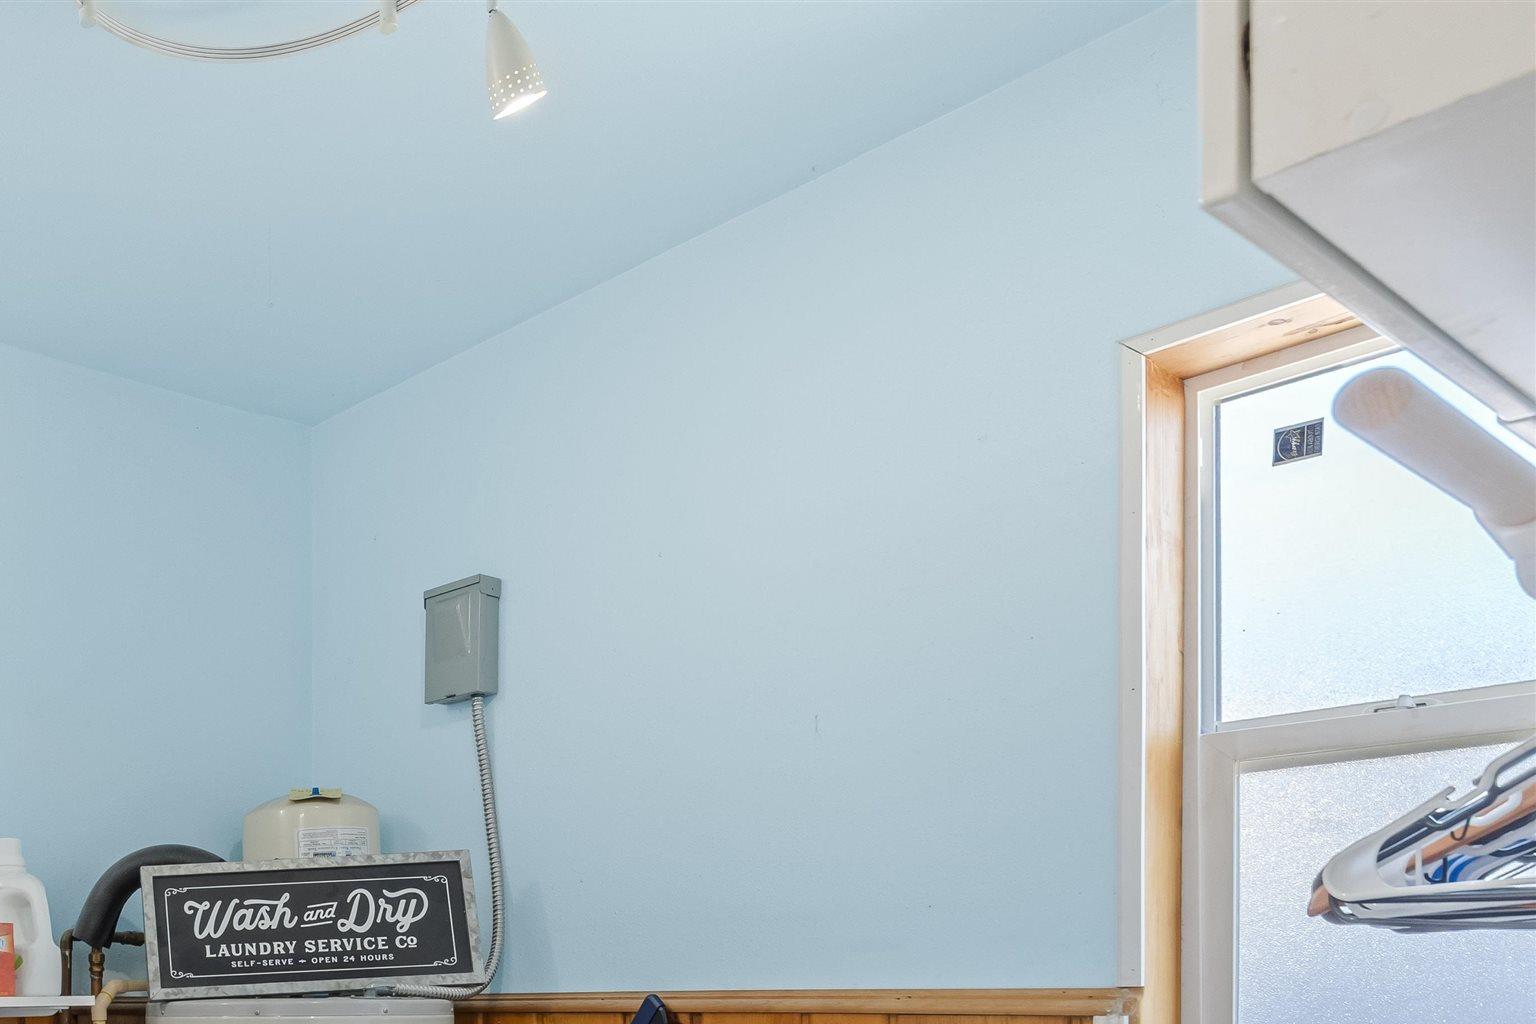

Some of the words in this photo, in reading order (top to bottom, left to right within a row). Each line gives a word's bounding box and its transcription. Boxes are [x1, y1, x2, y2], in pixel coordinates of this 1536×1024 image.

[184, 892, 298, 940] Wash
[302, 901, 339, 926] and
[337, 888, 429, 933] Dry
[205, 940, 297, 958] LAUNDRY
[304, 936, 389, 953] SERVICE
[231, 958, 294, 968] SELF-SERVE
[360, 954, 395, 962] HOURS
